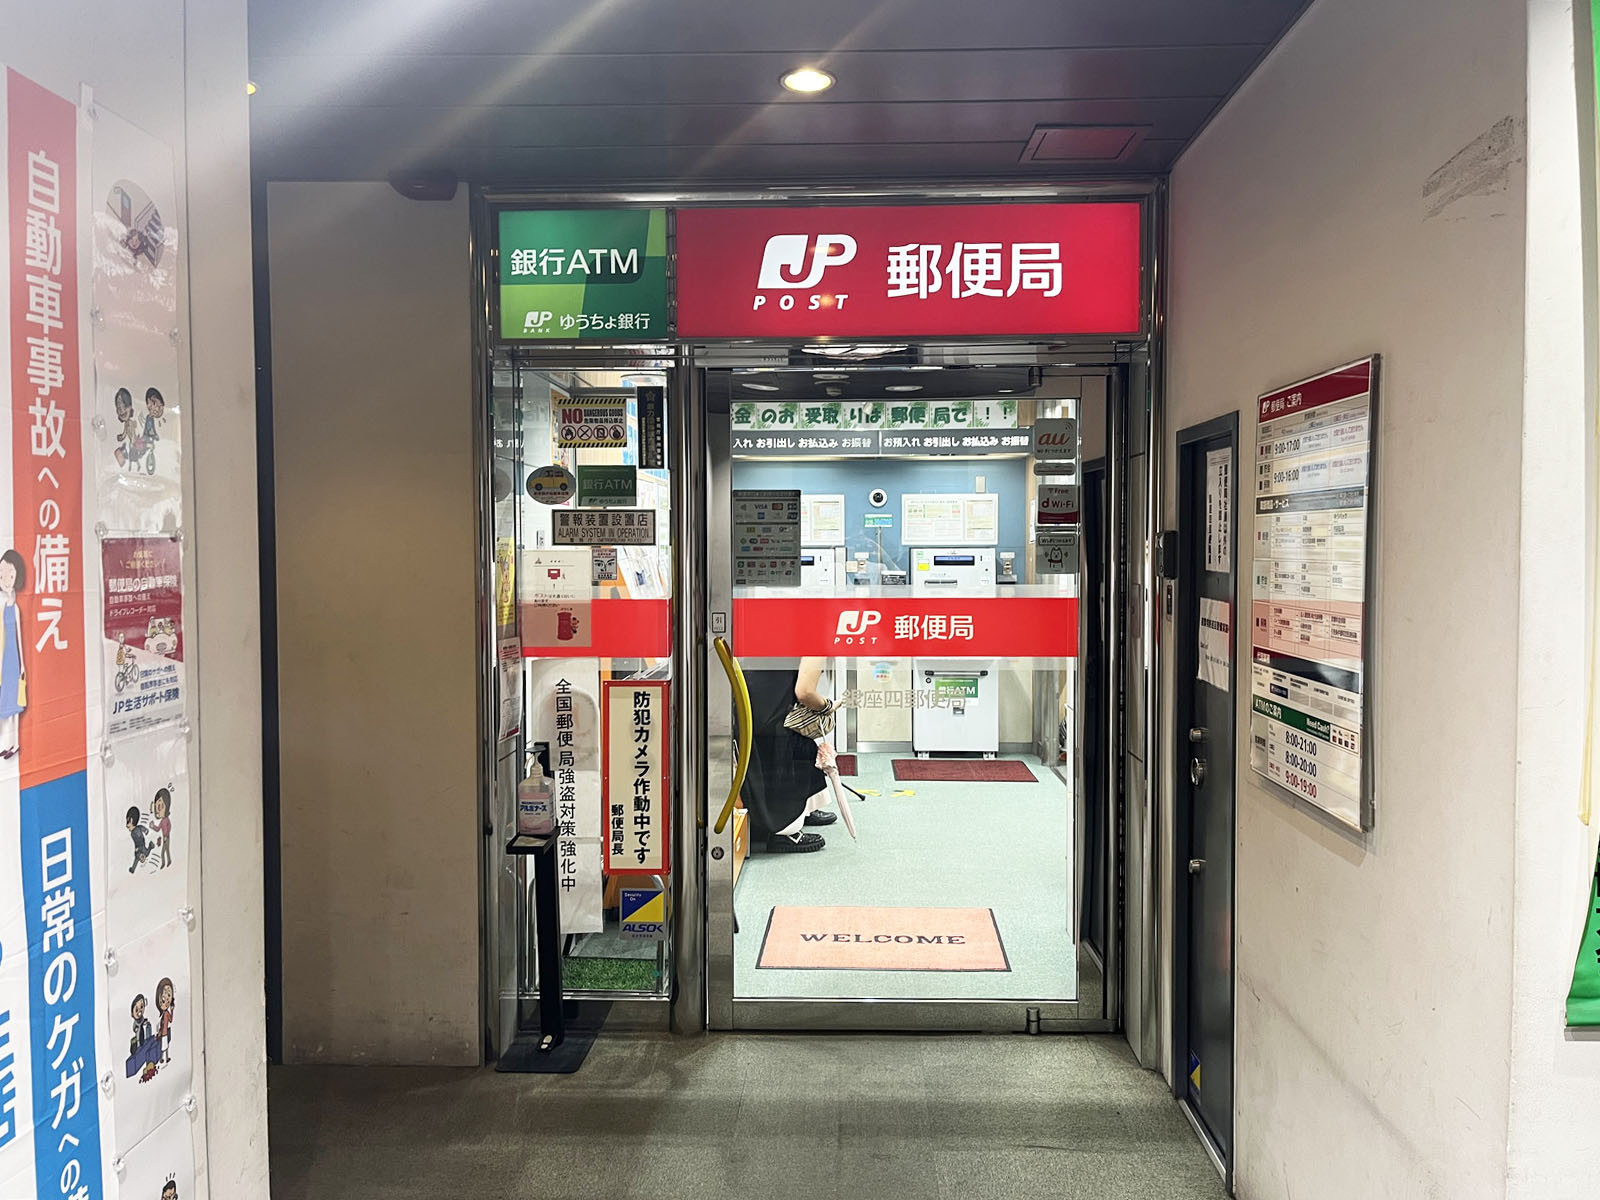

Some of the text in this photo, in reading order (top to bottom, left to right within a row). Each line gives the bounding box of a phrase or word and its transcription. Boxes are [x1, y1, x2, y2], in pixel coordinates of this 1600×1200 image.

[510, 248, 638, 276] 銀行ATM
[757, 234, 858, 289] JP
[886, 242, 1063, 299] 郵便局
[753, 294, 848, 311] POST
[524, 311, 552, 328] JP
[559, 312, 650, 331] ゆうちょ銀行
[24, 150, 70, 653] 自動車事故への備え
[1287, 393, 1302, 408] ご案内
[561, 408, 624, 424] NO DANGEROUS GOODS
[756, 437, 795, 449] お引出し
[798, 437, 839, 449] お払込み
[841, 438, 872, 448] お振替
[883, 436, 1029, 448] お預入れ お引出し お払込み お振替
[1038, 432, 1071, 446] au
[1274, 439, 1301, 455] 9:00-17:00
[559, 513, 648, 526] 警報装置設置店
[558, 527, 649, 538] ALARM SYSTEM IN OPERATION
[836, 610, 882, 635] JP
[894, 614, 974, 640] 郵便局
[834, 636, 878, 645] POST
[112, 687, 180, 715] JP生活サポート保険
[842, 689, 966, 709] 銀座四郵便局
[1285, 731, 1317, 756] 8:00-21:00
[1285, 750, 1317, 777] 8:00-20:00
[555, 678, 577, 893] 全国郵便局強盗対策強化中
[633, 690, 651, 865] 防犯カメラ作動中です
[1285, 770, 1317, 798] 9:00-19:00
[611, 804, 625, 856] 郵便局長
[622, 923, 664, 934] ALSOK
[800, 933, 966, 945] WELCOME
